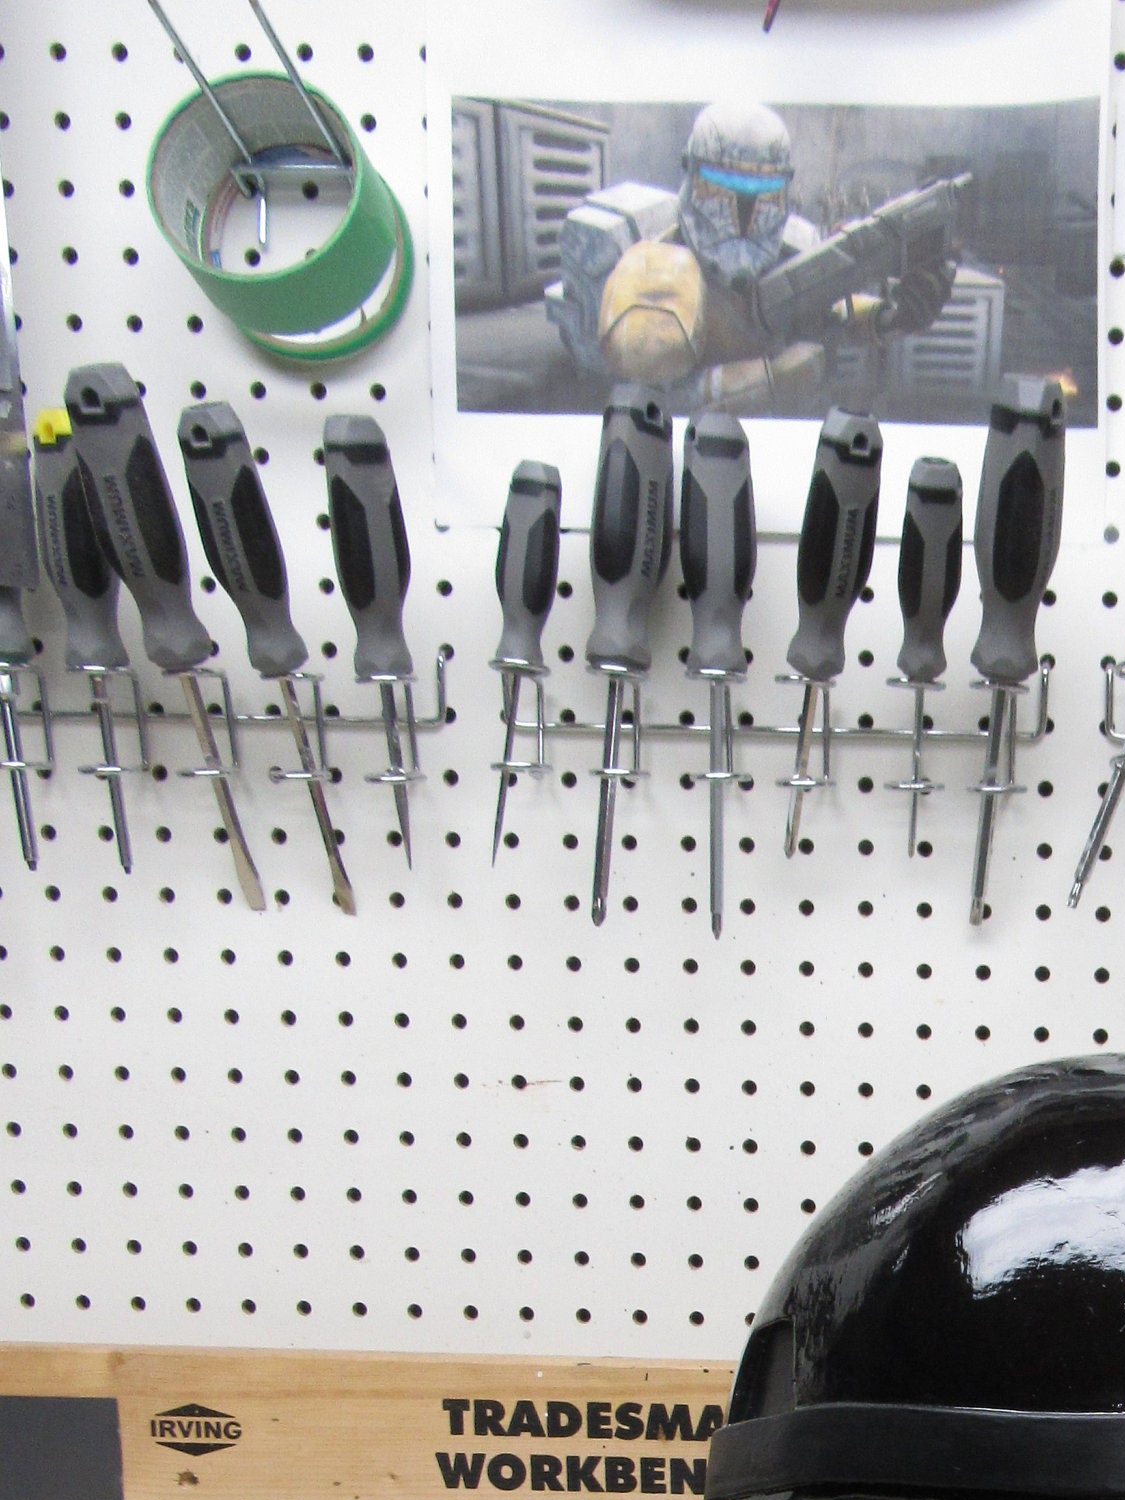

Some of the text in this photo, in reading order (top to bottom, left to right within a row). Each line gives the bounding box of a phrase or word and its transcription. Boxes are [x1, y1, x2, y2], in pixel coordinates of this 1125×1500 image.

[641, 480, 659, 577] MAXIMUM
[833, 508, 861, 599] MAXIMUM
[151, 1419, 242, 1440] IRVING
[435, 1452, 707, 1494] WORKBEN
